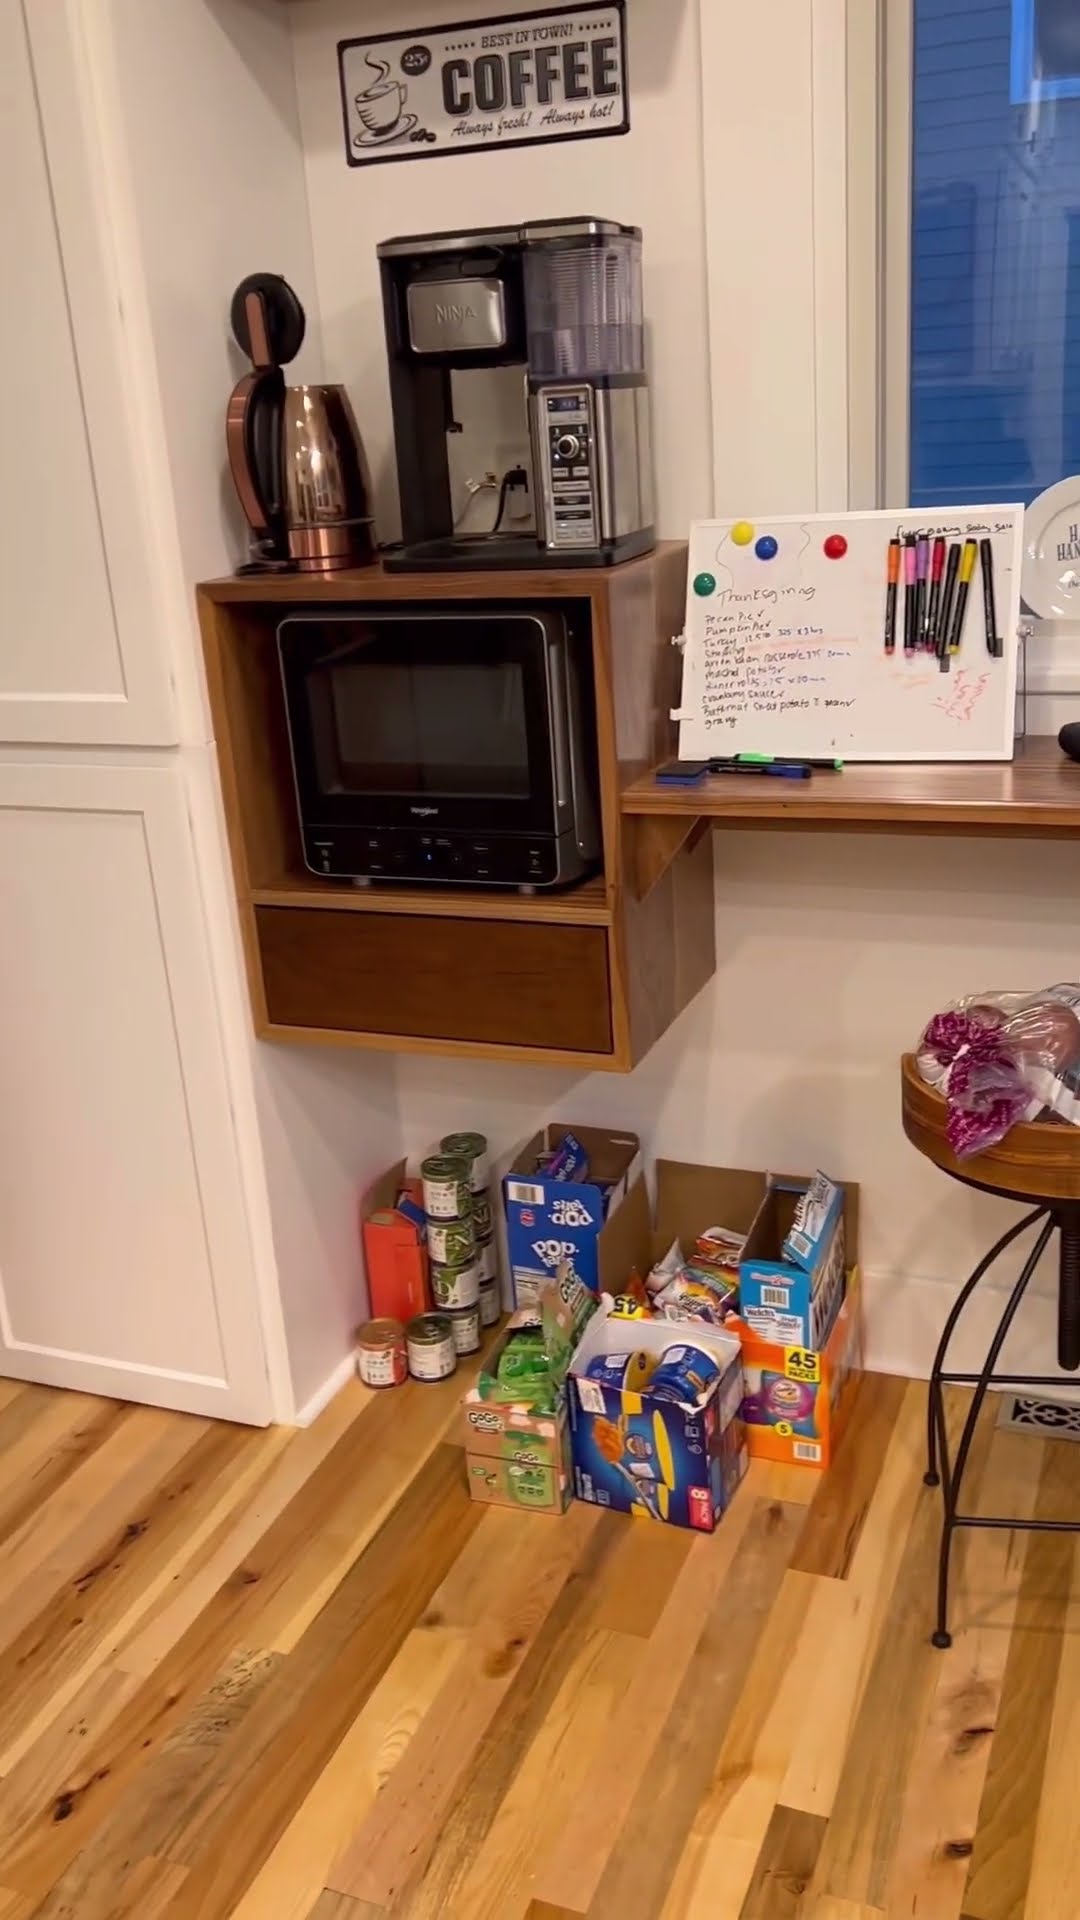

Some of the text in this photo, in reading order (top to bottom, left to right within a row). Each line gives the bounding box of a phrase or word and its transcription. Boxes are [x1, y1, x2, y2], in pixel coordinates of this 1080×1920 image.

[481, 23, 574, 49] BEST IN TOWN!
[441, 37, 620, 117] COFFEE
[451, 101, 615, 137] Always fresh! Always hot!
[435, 303, 478, 325] NINJA
[788, 1351, 816, 1369] 45
[468, 1412, 498, 1424] GoGo
